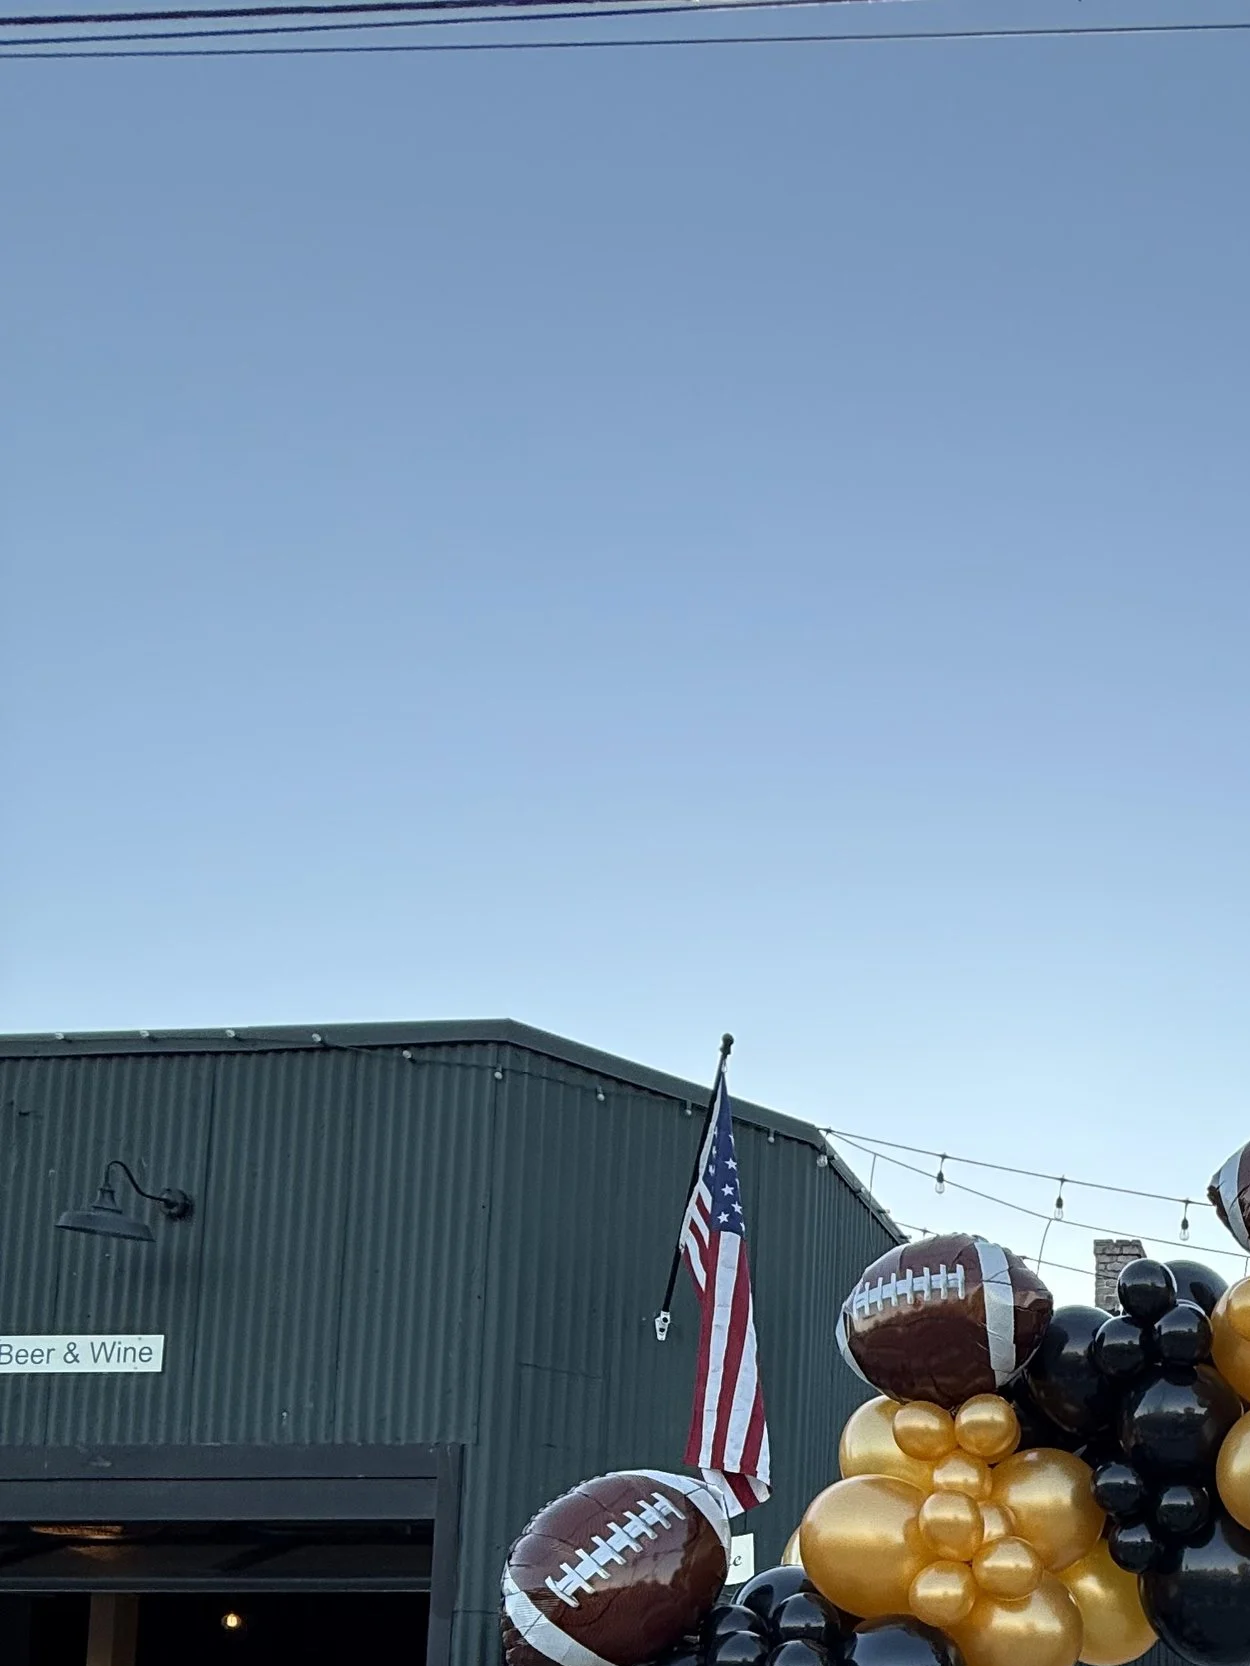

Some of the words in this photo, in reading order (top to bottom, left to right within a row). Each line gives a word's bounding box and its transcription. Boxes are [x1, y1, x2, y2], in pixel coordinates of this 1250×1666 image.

[0, 1343, 56, 1365] Beer
[63, 1341, 80, 1364] &
[90, 1340, 153, 1363] Wine
